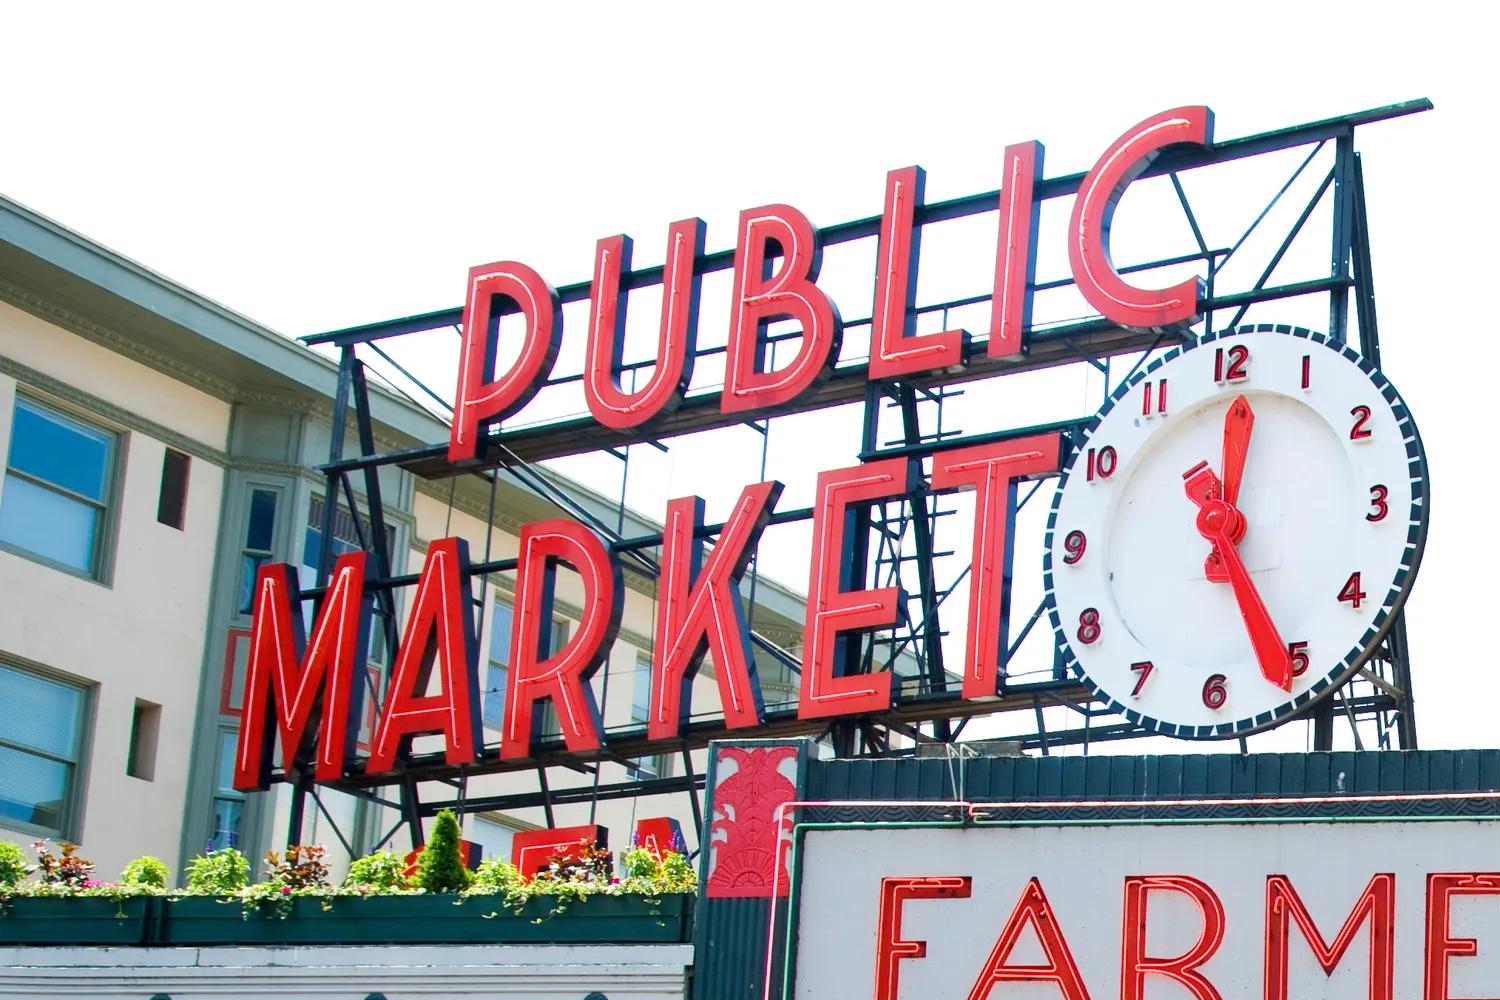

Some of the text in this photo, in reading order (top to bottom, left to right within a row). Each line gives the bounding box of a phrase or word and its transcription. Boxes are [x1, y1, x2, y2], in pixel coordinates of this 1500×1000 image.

[448, 105, 1214, 462] PUBLIC
[1214, 344, 1249, 383] 12
[1301, 355, 1312, 391] 1
[1142, 379, 1168, 416] 11
[1350, 405, 1372, 440] 2
[1086, 444, 1117, 482] 10
[1365, 484, 1389, 522] 3
[1063, 530, 1087, 565] 9
[1337, 571, 1367, 609] 4
[233, 434, 1072, 793] MARKET
[1076, 608, 1101, 643] 8
[1287, 641, 1310, 678] 5
[1130, 661, 1154, 697] 7
[1202, 673, 1227, 710] 6
